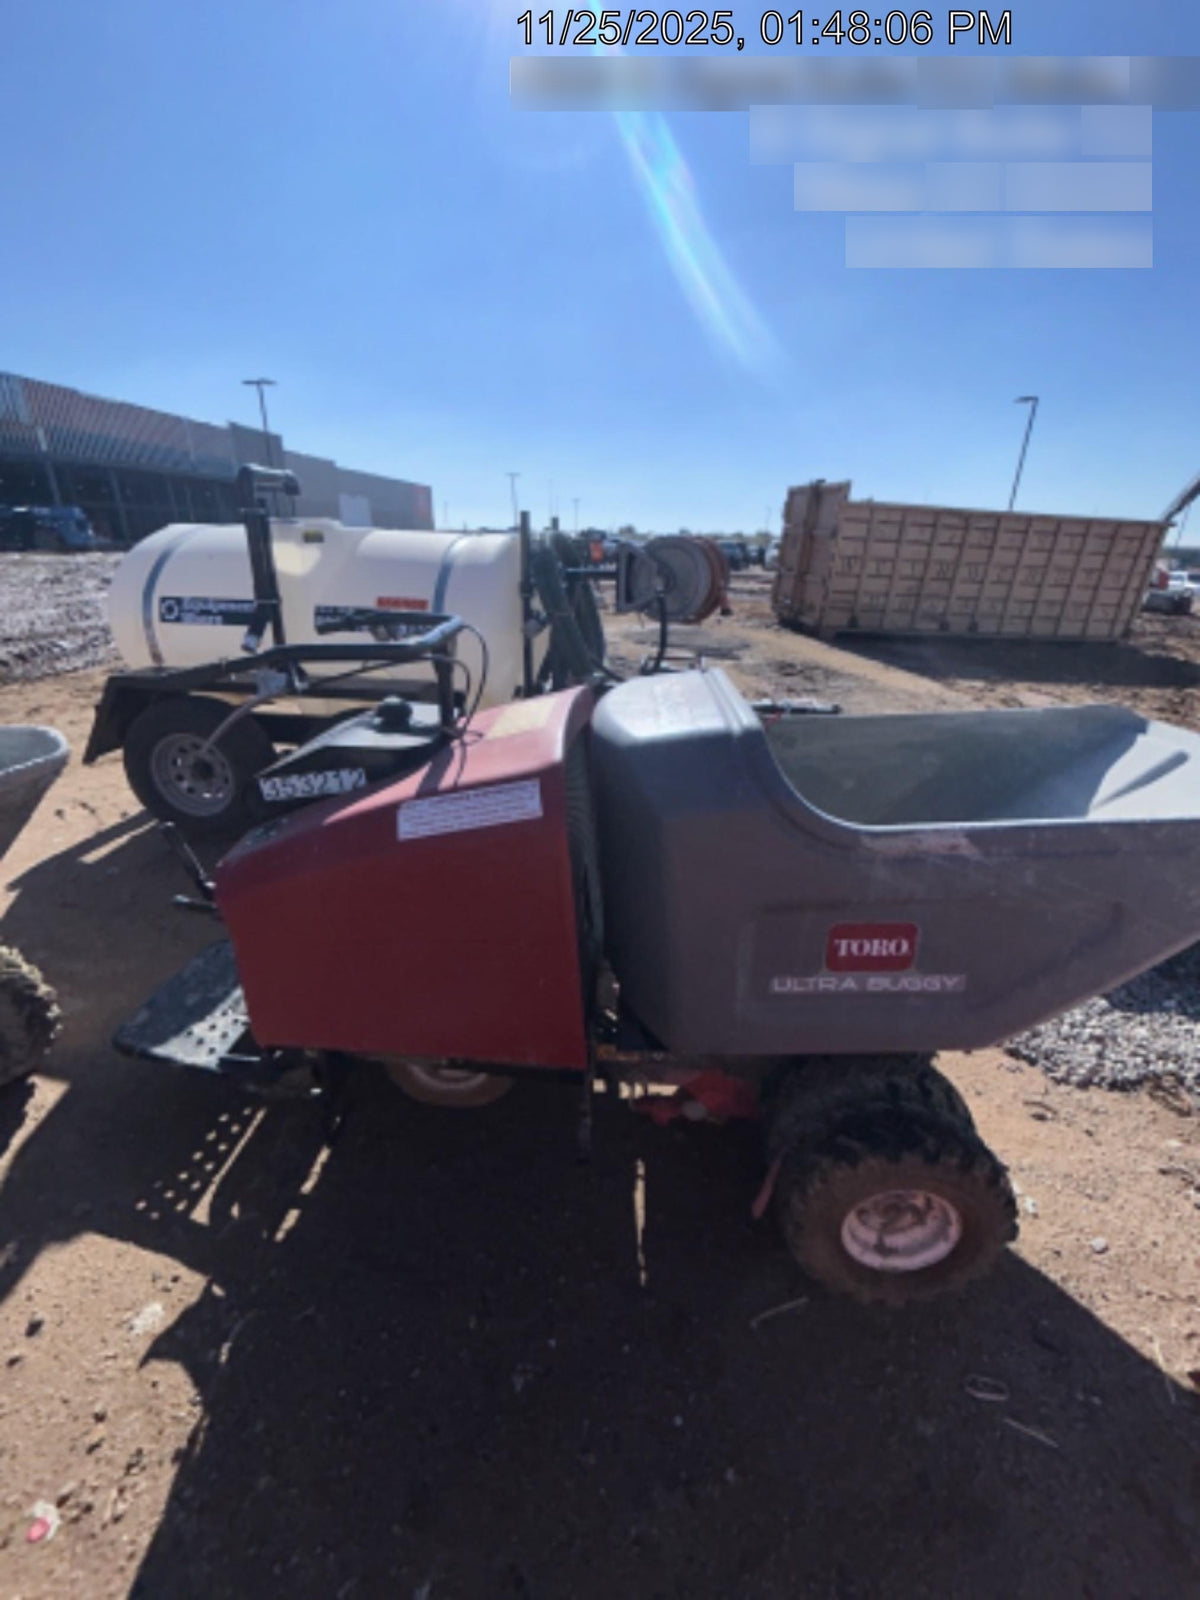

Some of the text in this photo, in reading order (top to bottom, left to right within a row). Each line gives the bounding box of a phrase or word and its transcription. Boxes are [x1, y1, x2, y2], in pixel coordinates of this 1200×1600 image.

[834, 939, 909, 957] TORO
[772, 975, 961, 992] ULTRA BUGGY
